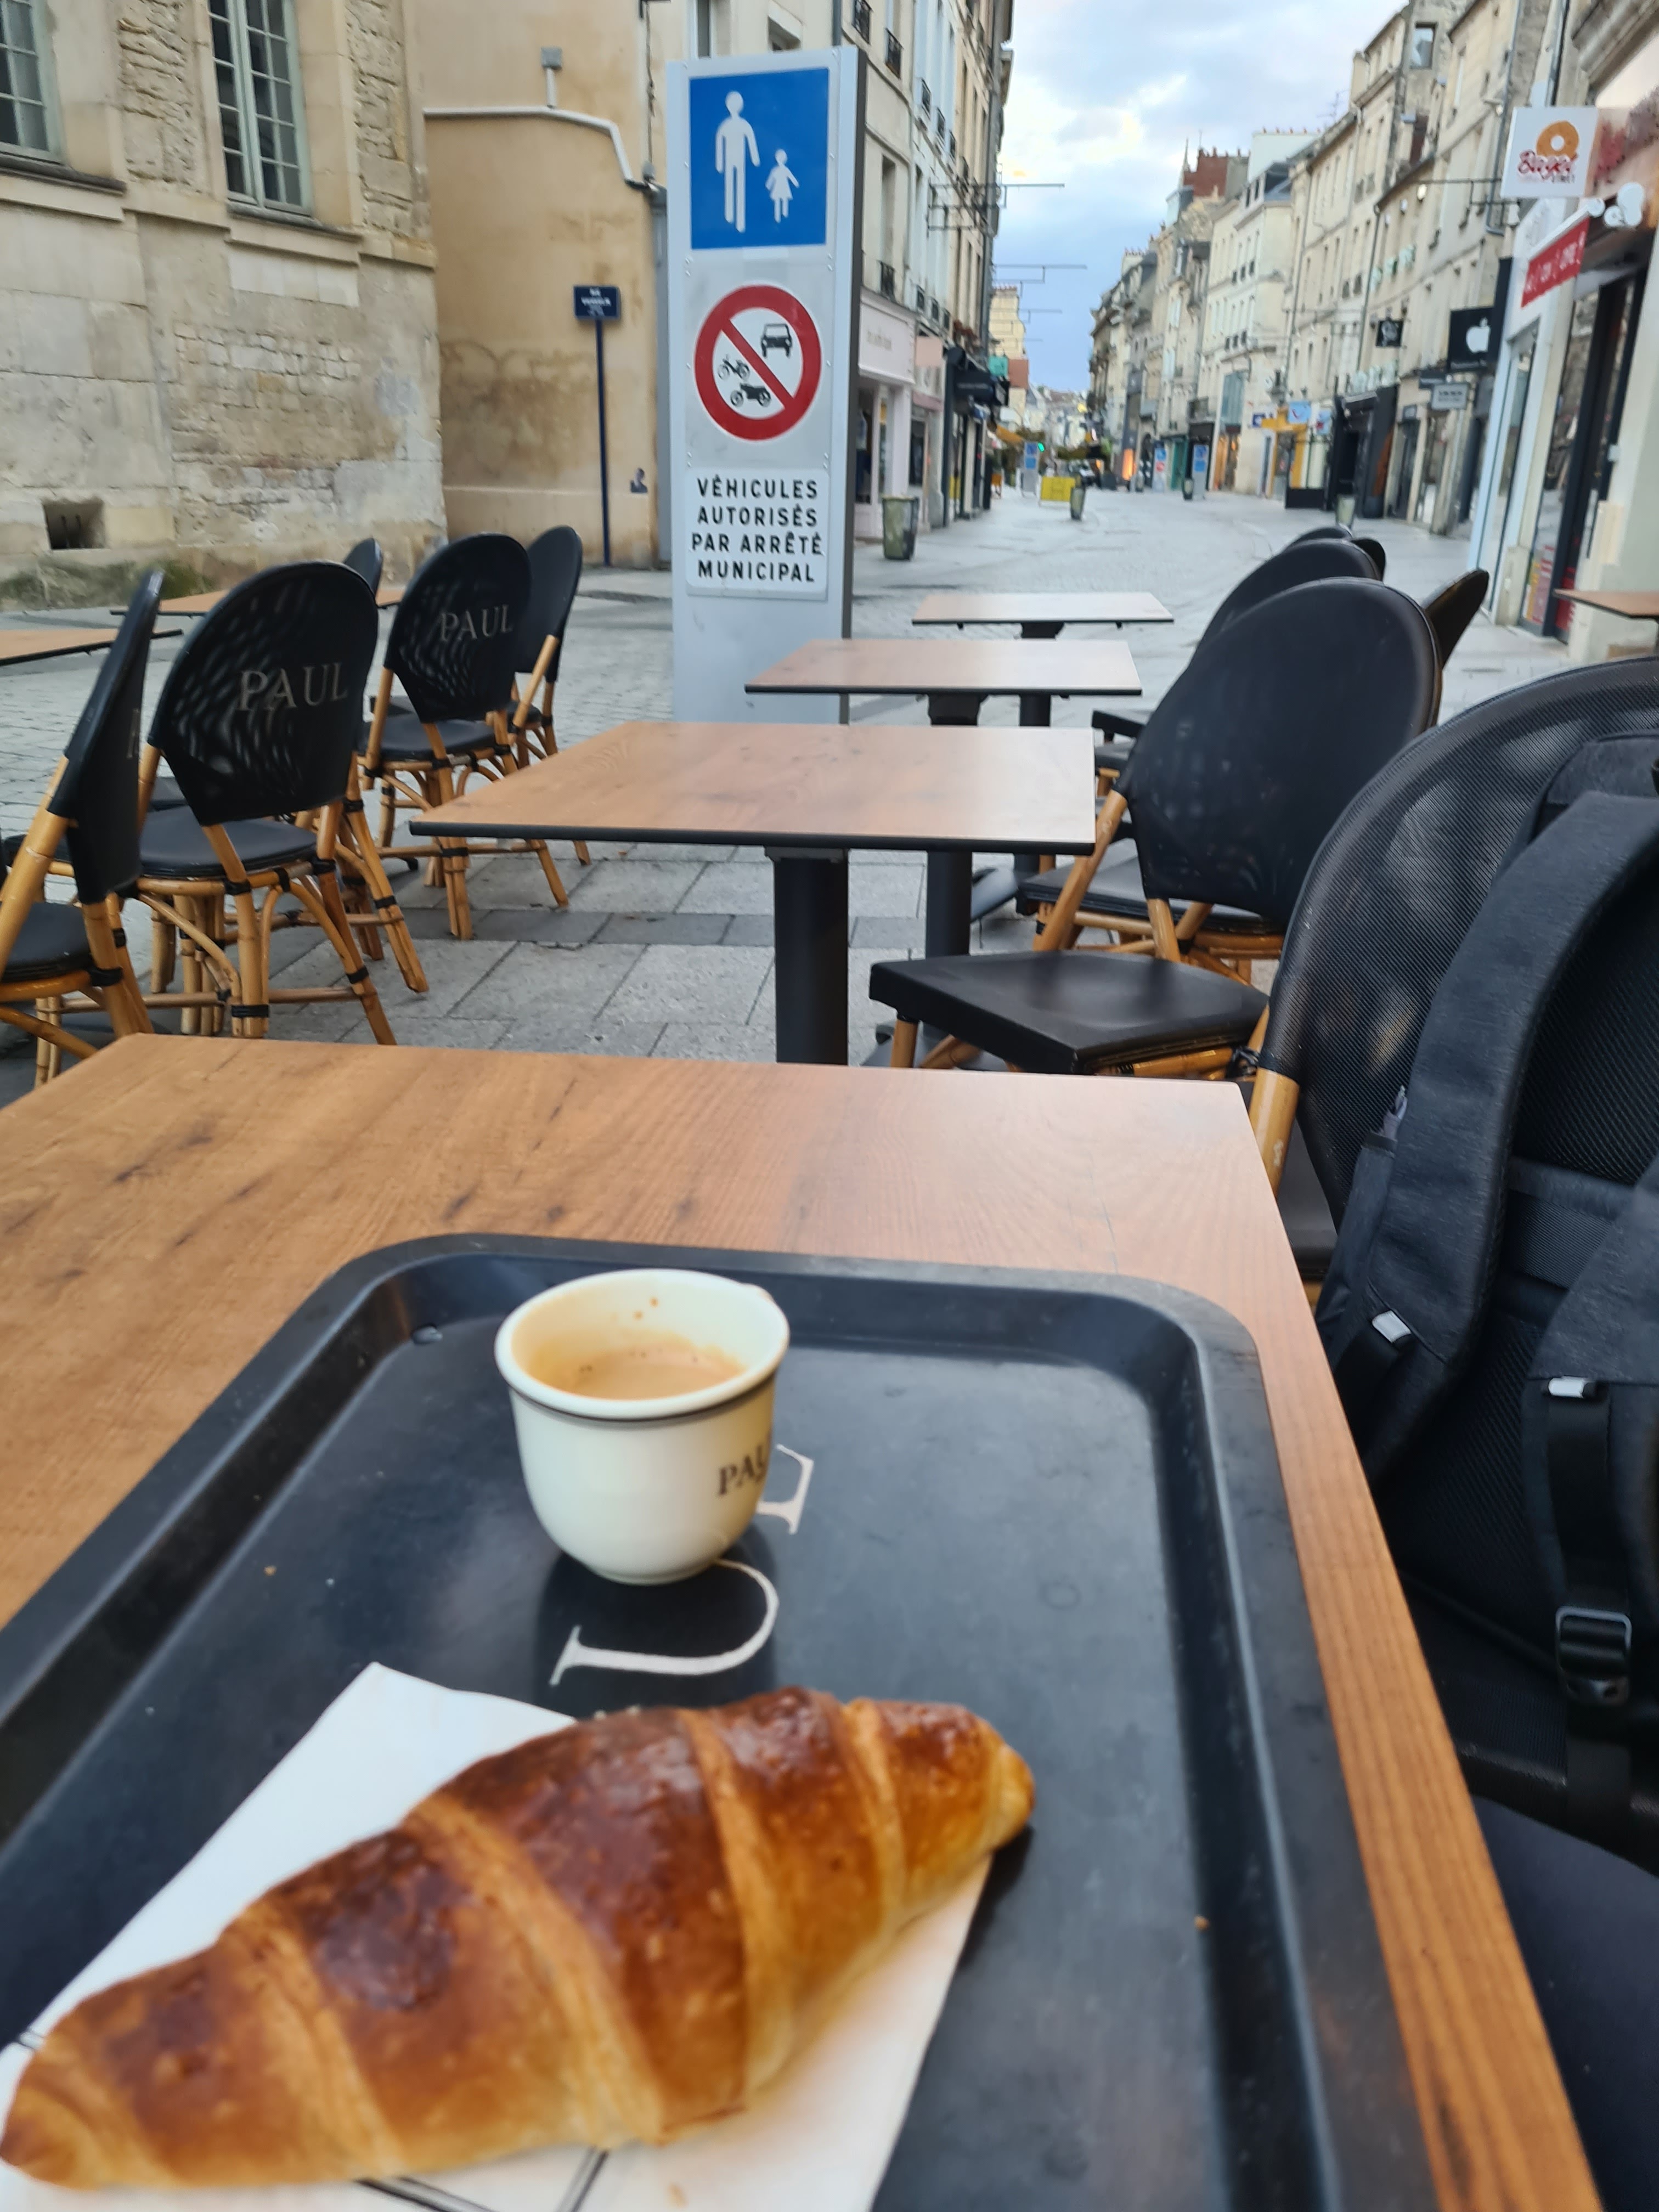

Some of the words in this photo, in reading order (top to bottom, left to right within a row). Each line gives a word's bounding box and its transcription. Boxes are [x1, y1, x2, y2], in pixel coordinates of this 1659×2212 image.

[697, 474, 817, 499] VÉHICULES
[697, 503, 817, 527] AUTORISÉS
[692, 532, 730, 552] PAR
[740, 531, 822, 555] ARRÊTÉ
[698, 560, 815, 582] MUNICIPAL
[441, 604, 514, 642] PAUL
[236, 662, 348, 712] PAUL
[718, 1443, 766, 1497] PAU
